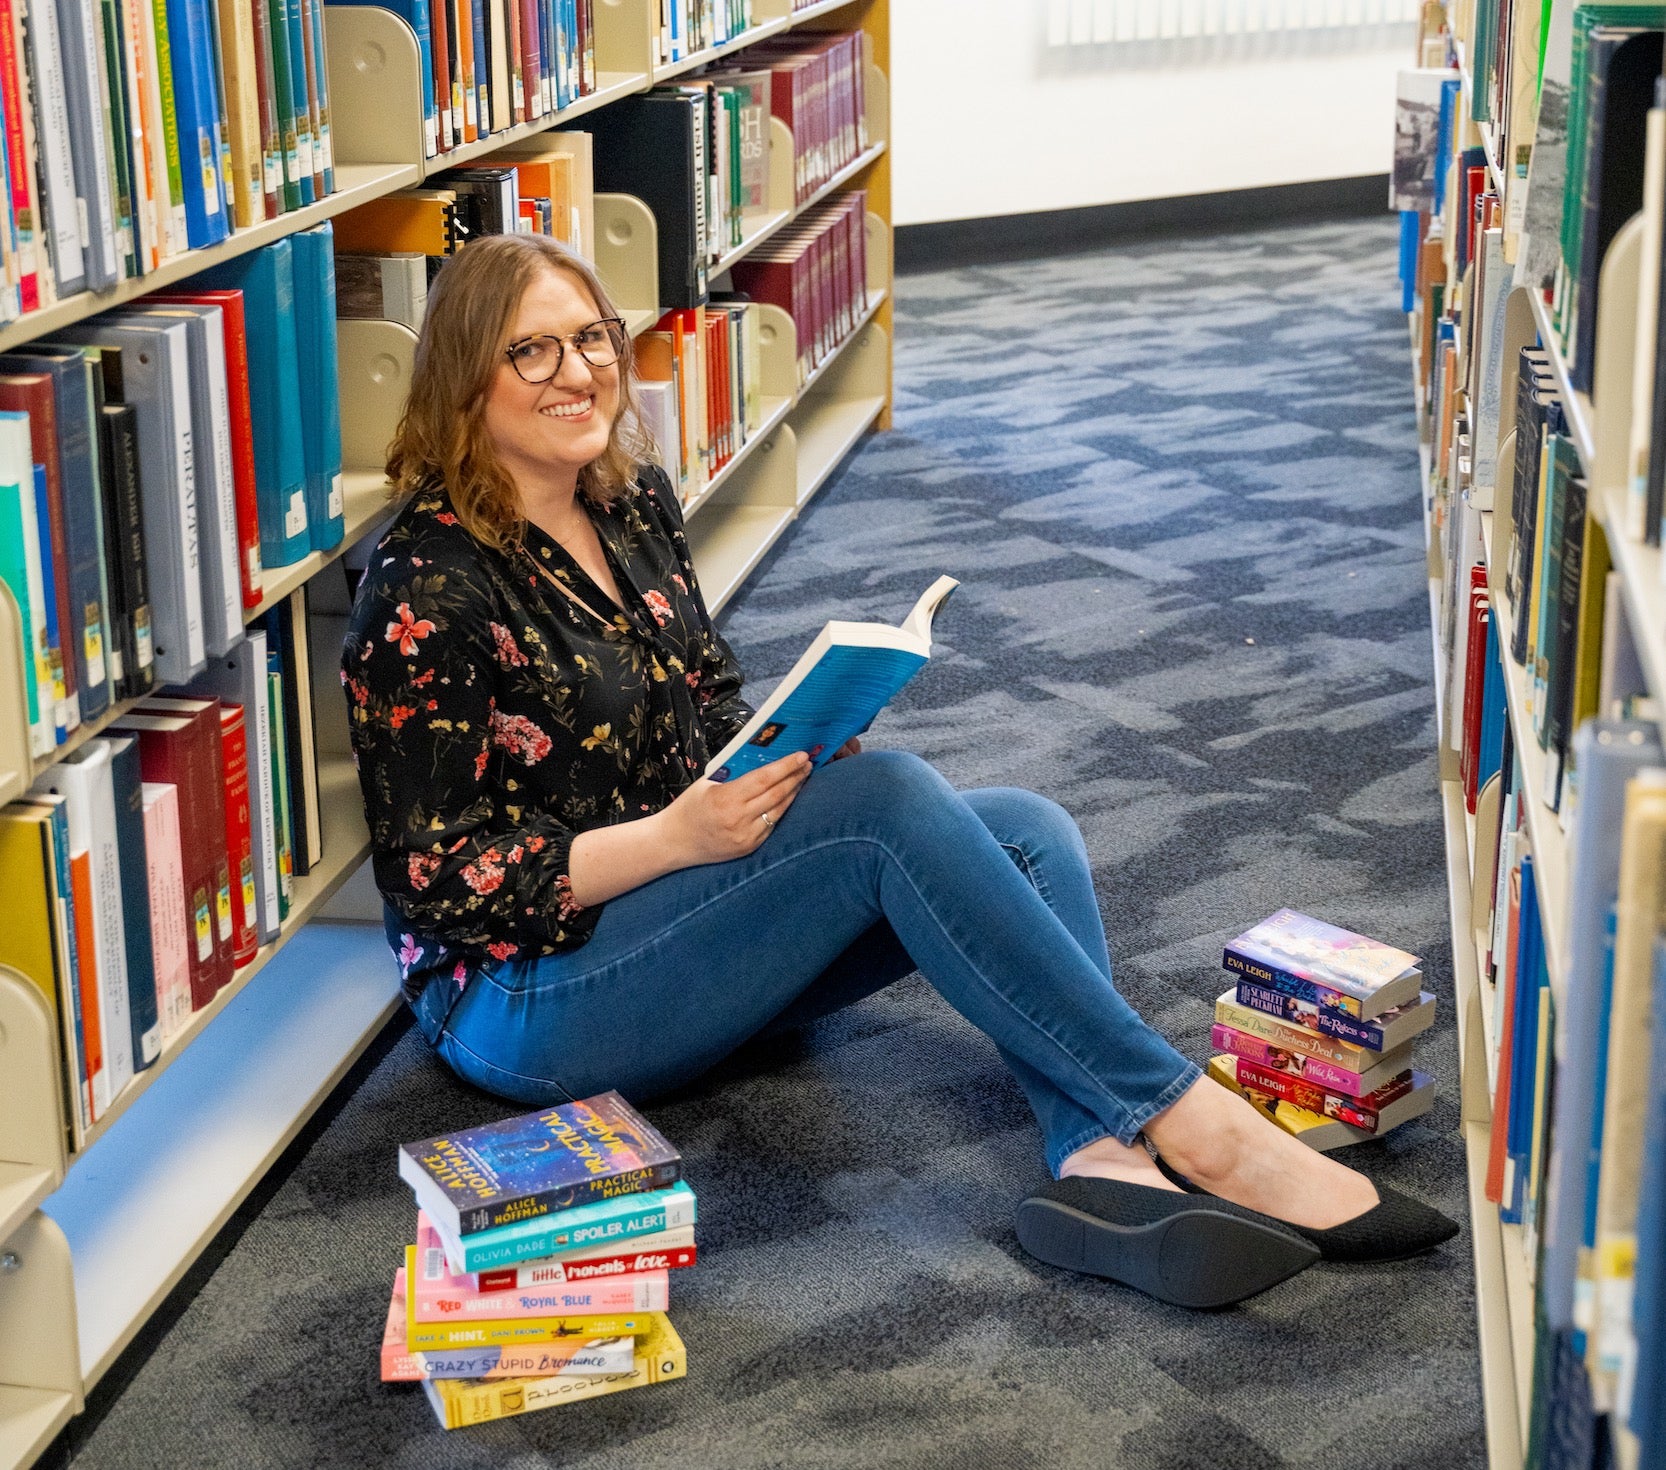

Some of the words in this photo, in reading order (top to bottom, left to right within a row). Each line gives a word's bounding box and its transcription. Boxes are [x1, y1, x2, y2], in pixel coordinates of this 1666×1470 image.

[158, 0, 168, 31] ILY
[159, 38, 178, 168] ASSOCIATIONS
[123, 431, 139, 527] ALEXANDER
[265, 817, 273, 871] KENTUCKY
[1227, 957, 1244, 971] EVA
[1245, 964, 1272, 981] LEIGH
[1250, 997, 1283, 1016] PECKHAM
[1251, 987, 1285, 1006] SCARLETT
[1224, 1008, 1249, 1027] Tessa
[1248, 1017, 1273, 1034] Dare
[1319, 1014, 1333, 1028] The
[1331, 1018, 1358, 1036] Rakess
[1272, 1028, 1310, 1050] Duchess
[1308, 1039, 1333, 1058] Deal
[1240, 1069, 1257, 1082] EVA
[1259, 1076, 1286, 1093] LEIGH
[539, 1112, 612, 1174] PRACTICAL
[576, 1114, 628, 1156] MAGIC
[423, 1154, 467, 1189] ALICE
[433, 1139, 497, 1199] HOFFMAN
[590, 1167, 654, 1192] PRACTICAL
[603, 1181, 642, 1198] MAGIC
[495, 1204, 548, 1224] HOFFMAN
[505, 1197, 536, 1212] ALICE
[473, 1248, 511, 1264] OLIVIA
[516, 1238, 546, 1255] DADE
[573, 1222, 623, 1243] SPOILER
[626, 1214, 666, 1232] ALERT
[532, 1268, 562, 1282] little
[634, 1254, 671, 1271] love.
[436, 1299, 462, 1313] RED
[466, 1298, 503, 1312] WHITE
[519, 1296, 558, 1309] ROYAL
[561, 1295, 593, 1307] BLUE
[448, 1330, 486, 1343] HINT,
[491, 1329, 511, 1338] DANI
[514, 1327, 545, 1337] BROWN
[425, 1360, 476, 1373] CRAZY
[482, 1358, 535, 1370] STUPID
[538, 1354, 606, 1371] Bromance
